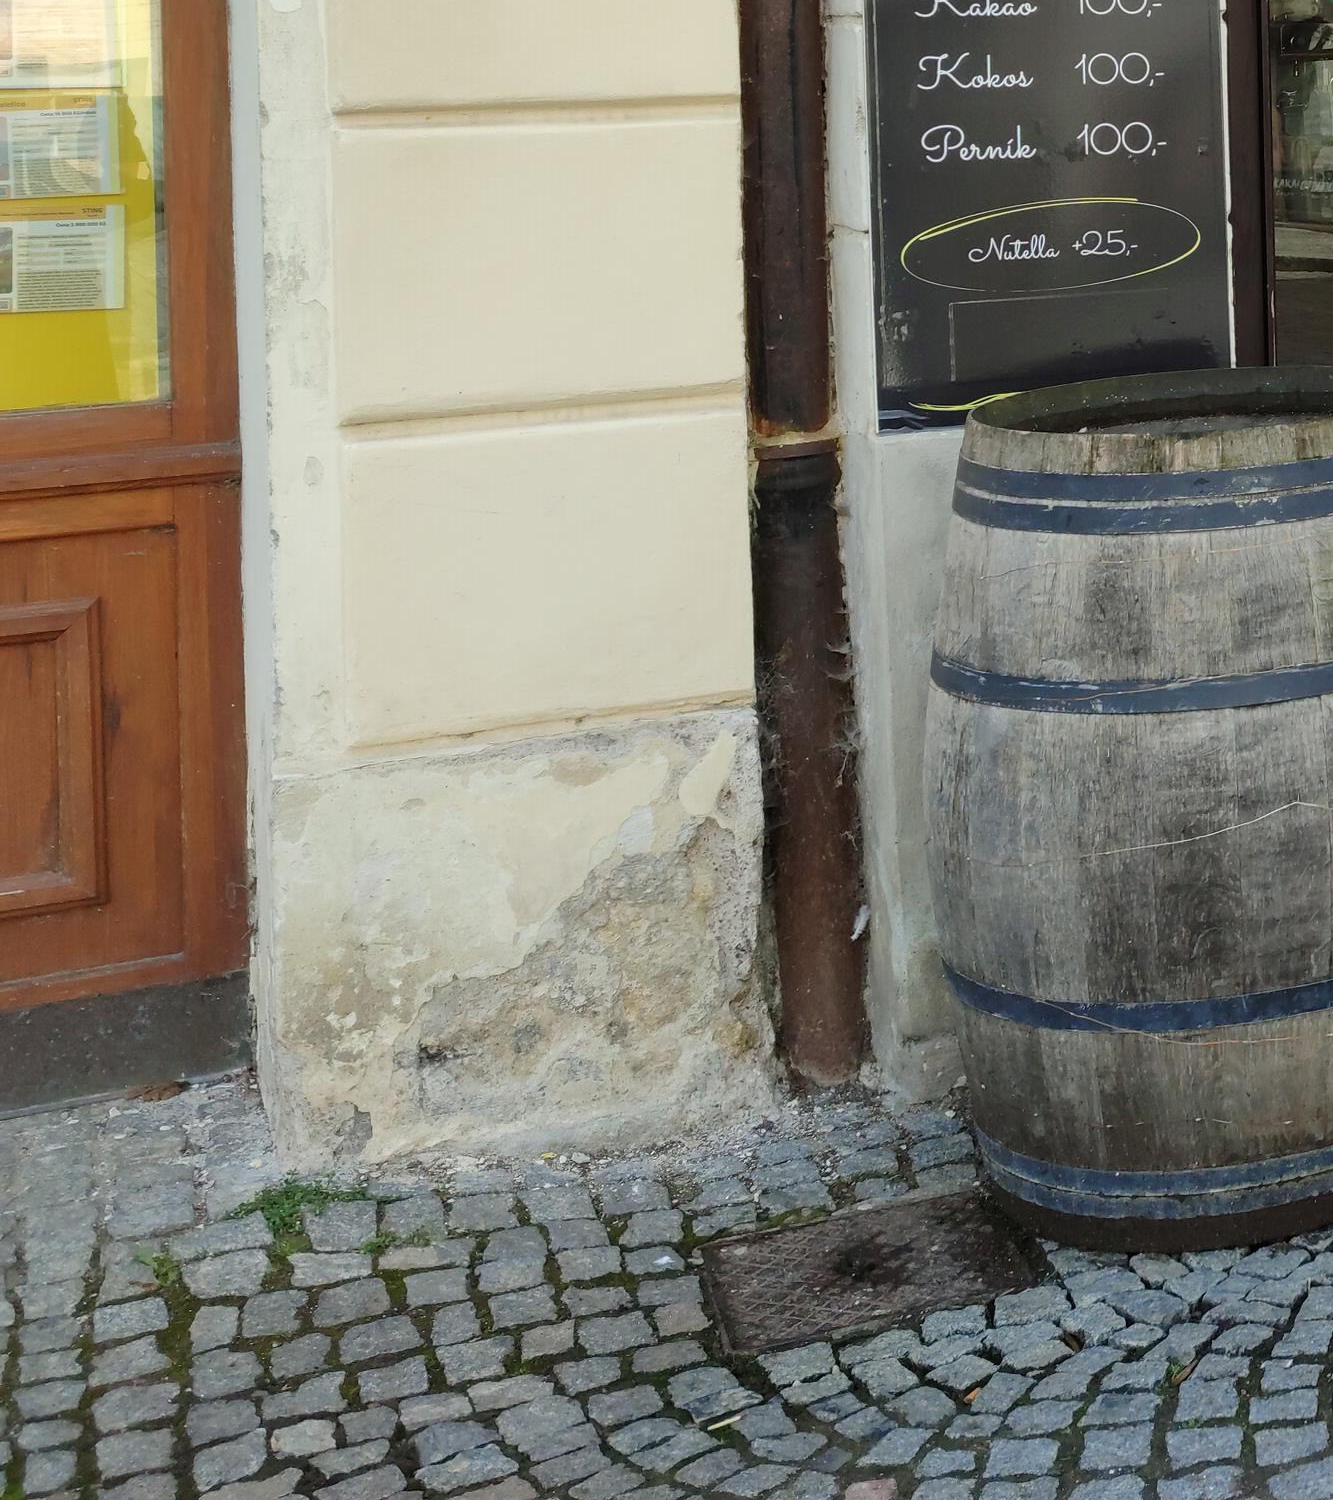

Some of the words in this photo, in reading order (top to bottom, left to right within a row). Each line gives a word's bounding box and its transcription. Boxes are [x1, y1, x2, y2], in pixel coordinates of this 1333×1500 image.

[917, 52, 1034, 90] Kokos
[1074, 52, 1165, 87] 100,-
[921, 124, 1037, 162] Perník
[1076, 121, 1167, 156] 100,-
[968, 235, 1060, 263] Nutella
[1072, 230, 1138, 257] +25,-
